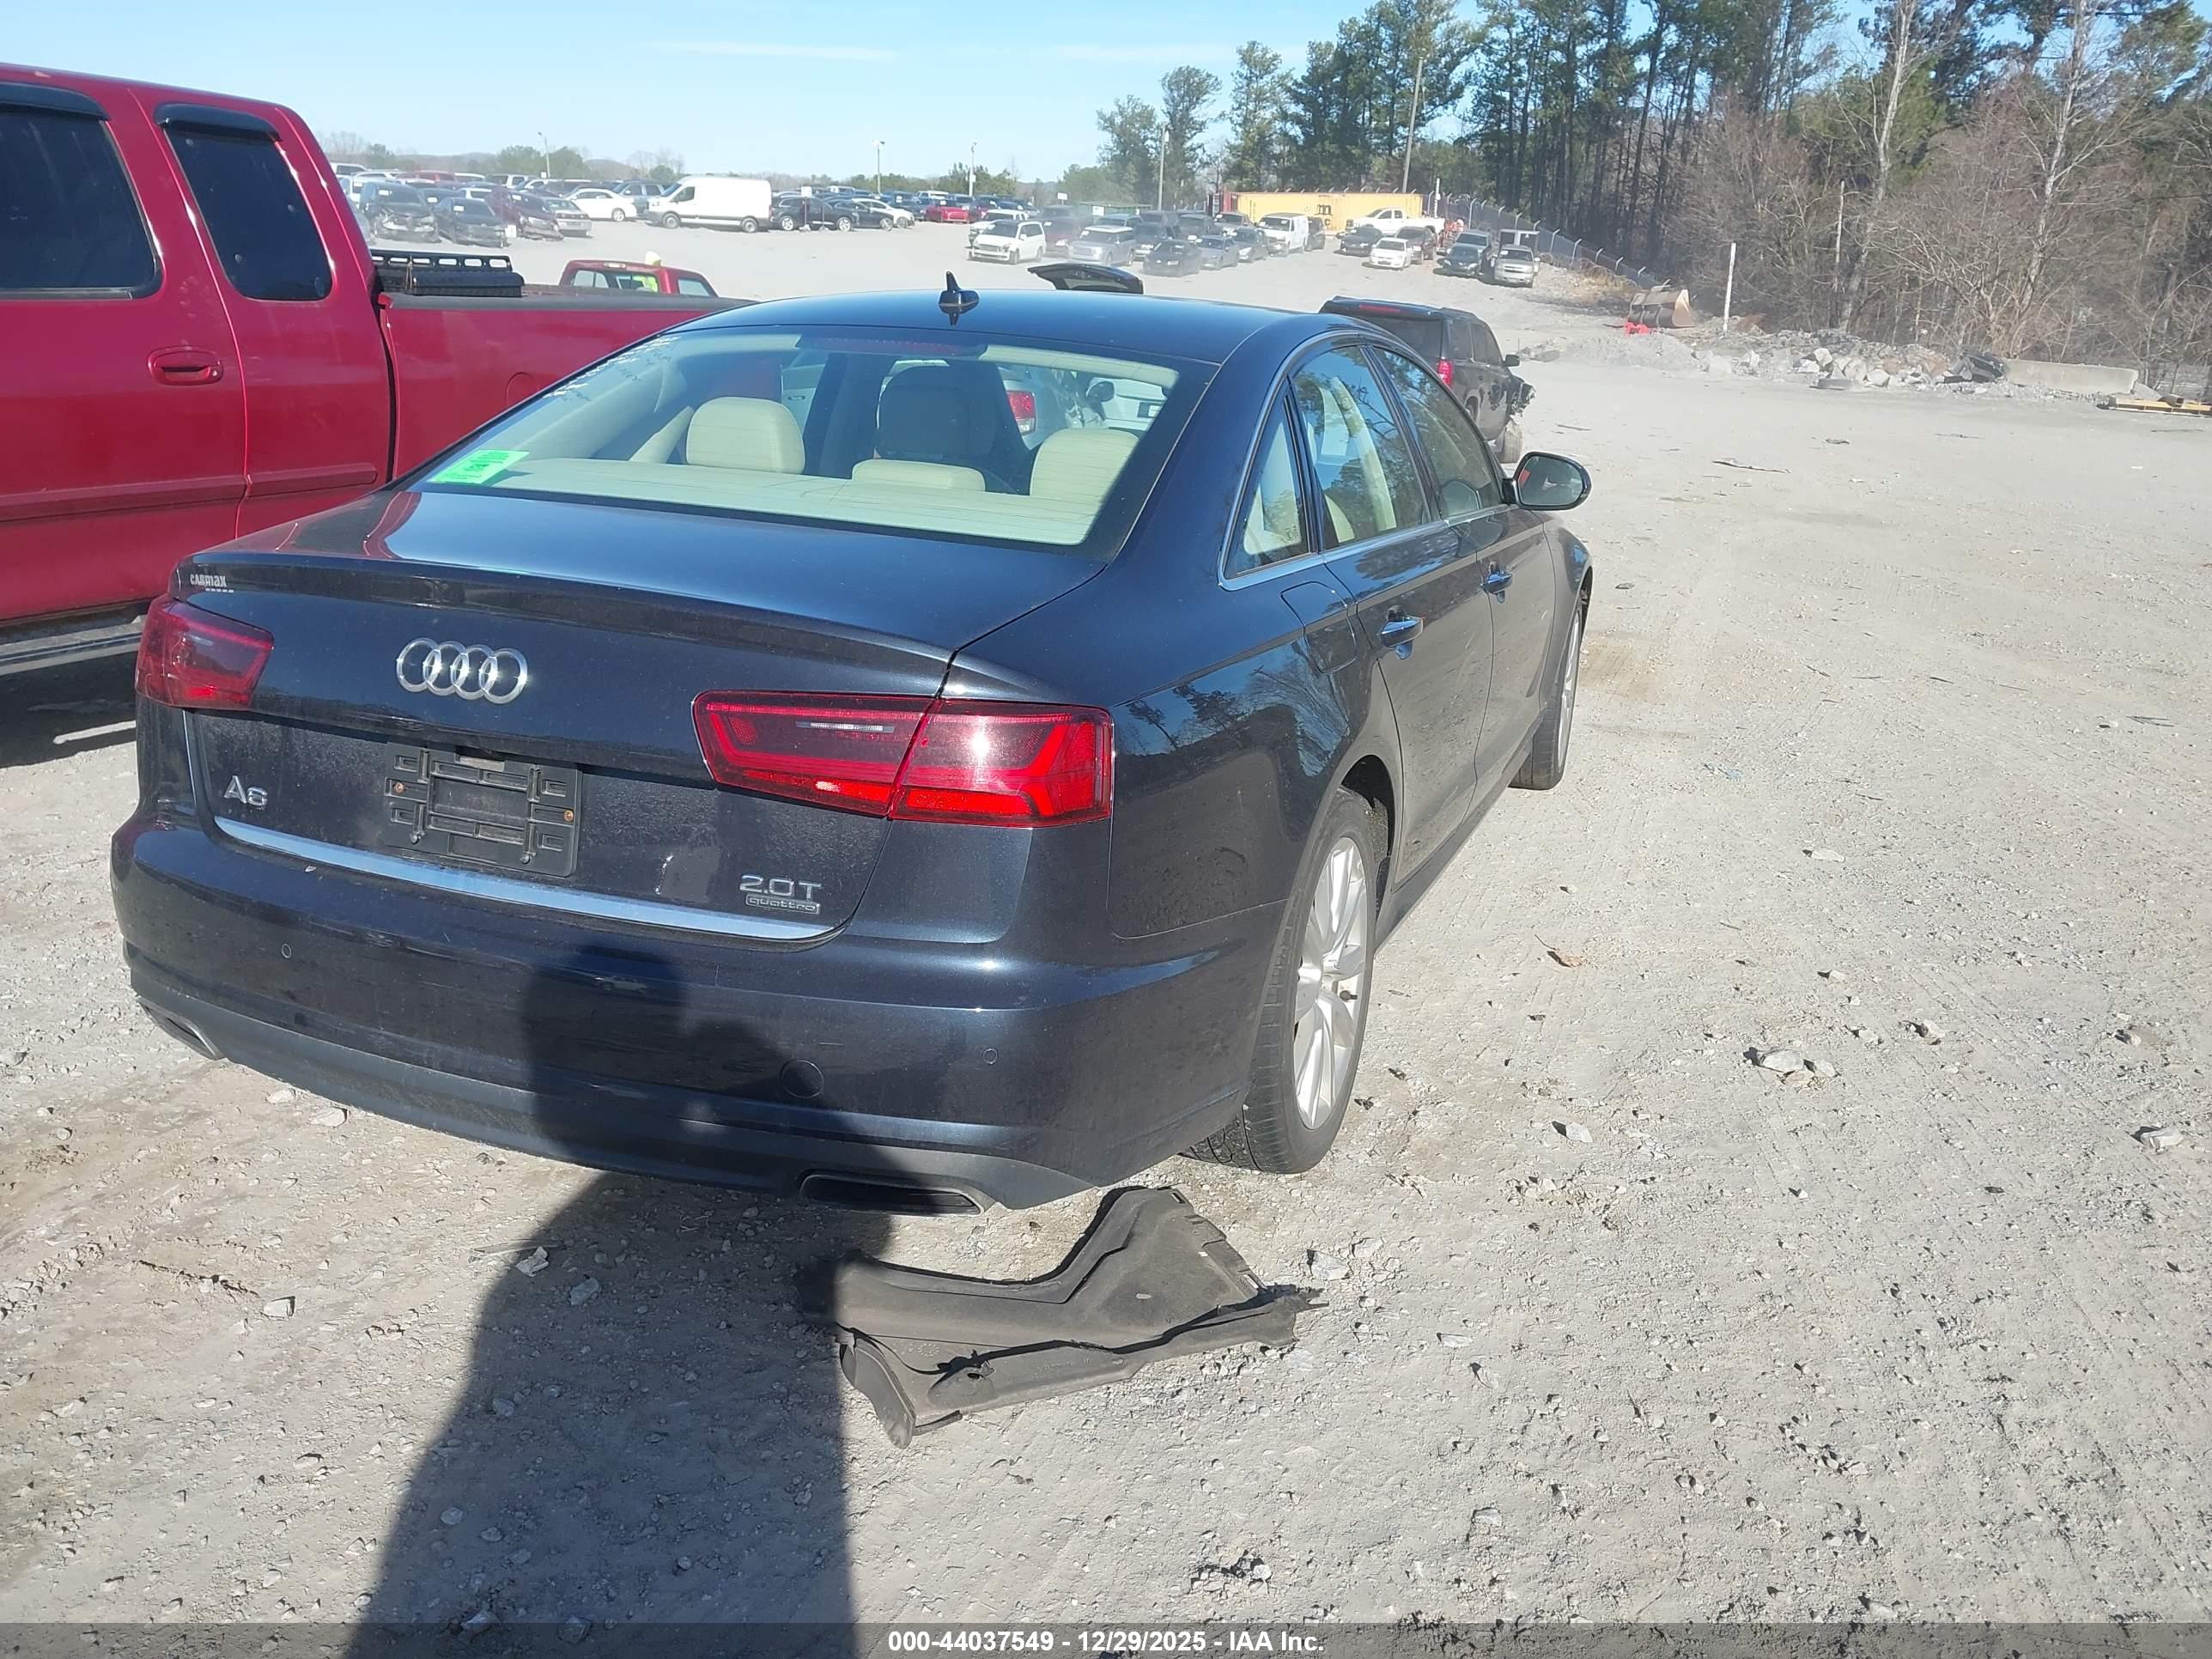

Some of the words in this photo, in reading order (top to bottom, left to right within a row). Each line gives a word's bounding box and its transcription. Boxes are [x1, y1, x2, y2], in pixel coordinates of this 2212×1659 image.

[223, 775, 268, 810] A6
[739, 874, 822, 902] 2.0T
[749, 896, 817, 912] quattro
